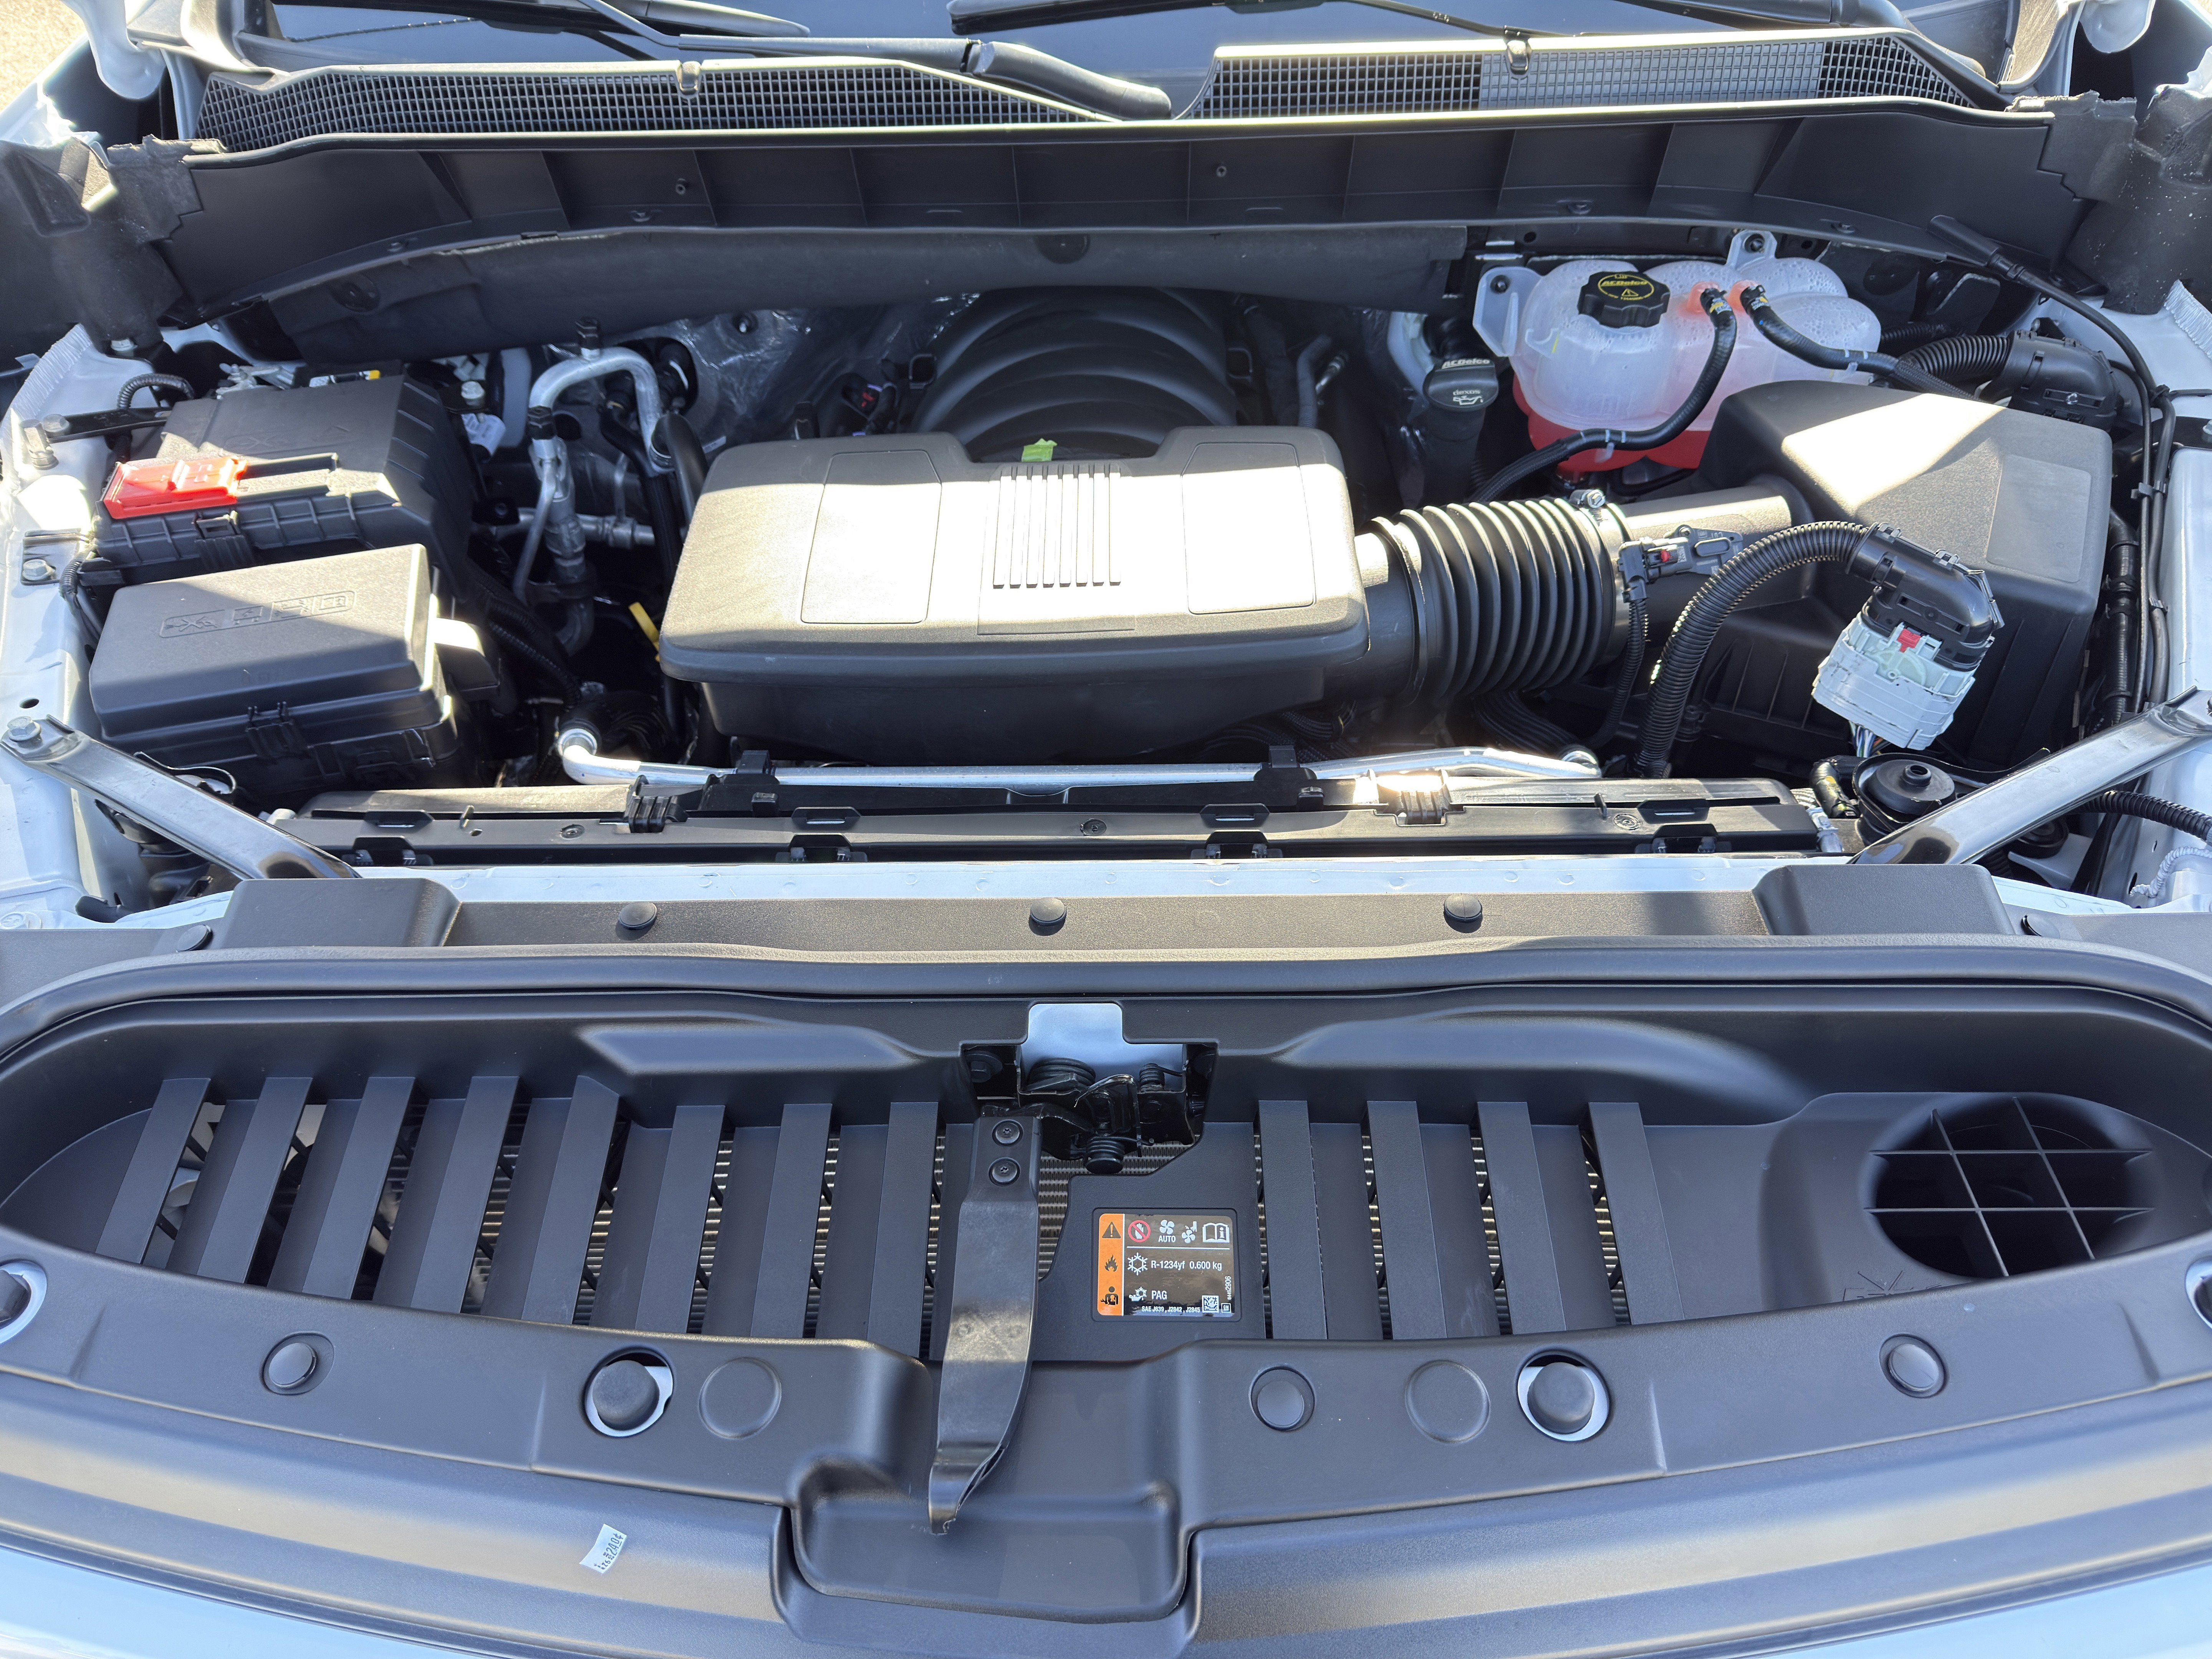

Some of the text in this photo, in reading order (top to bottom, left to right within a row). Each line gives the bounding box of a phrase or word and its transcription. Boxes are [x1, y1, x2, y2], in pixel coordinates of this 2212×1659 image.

[1441, 358, 1490, 369] ACDelco
[1151, 1260, 1222, 1271] R-1234yf 0.600 kg
[1151, 1290, 1167, 1300] PAG
